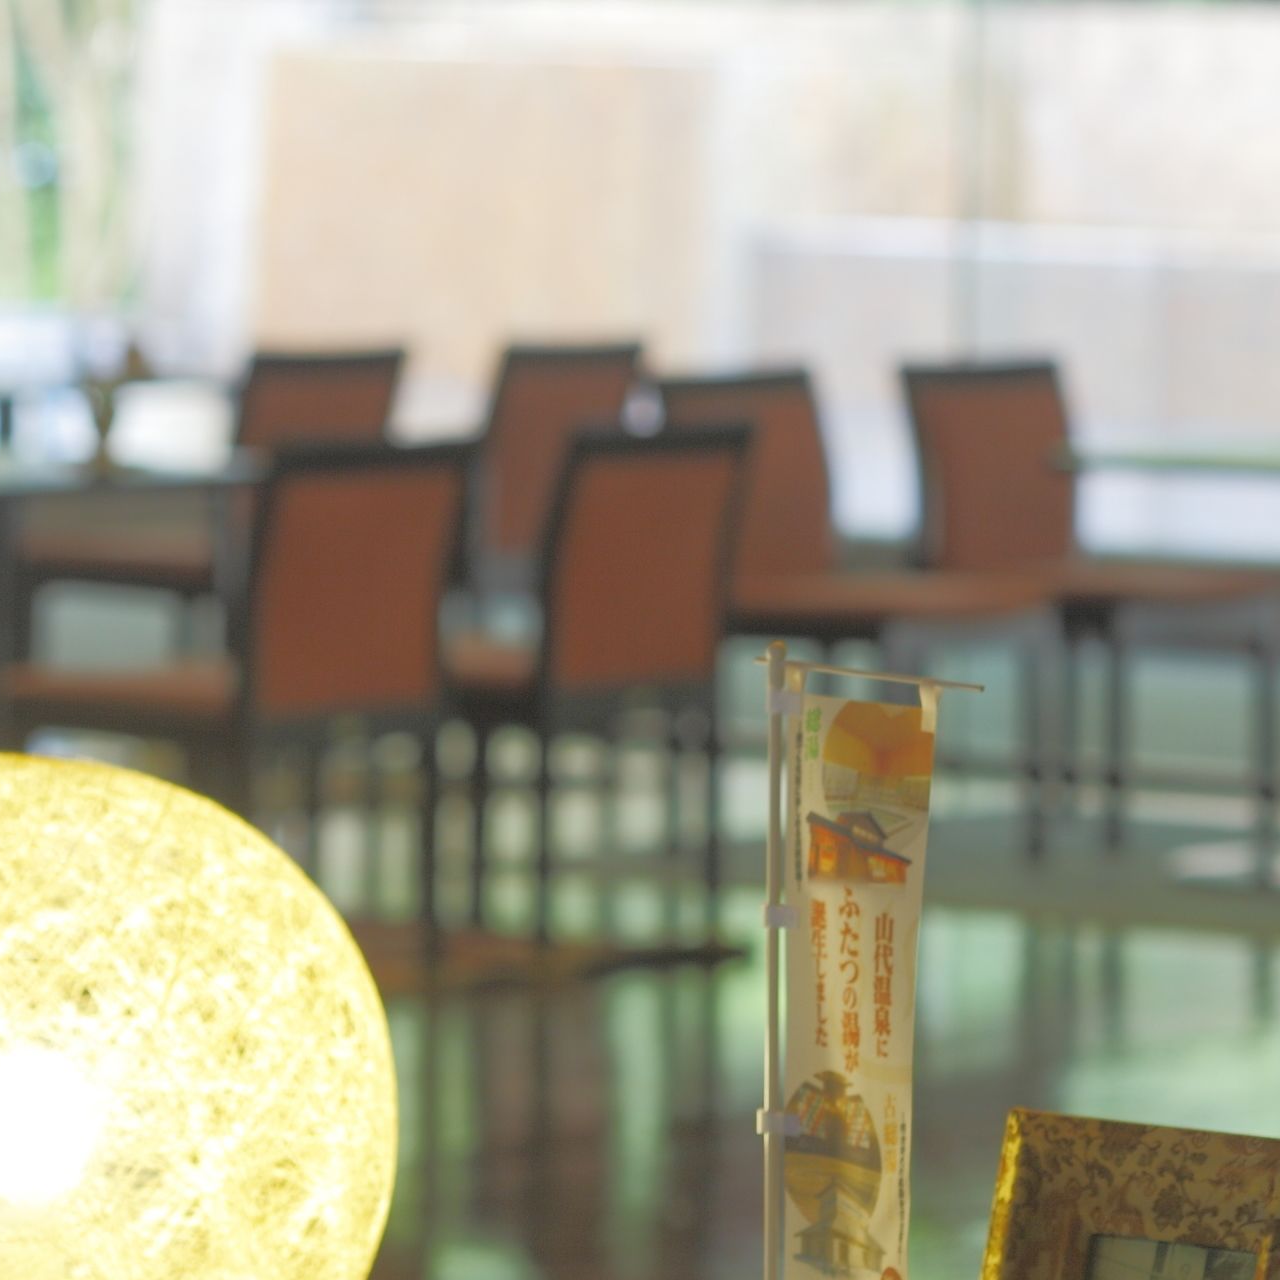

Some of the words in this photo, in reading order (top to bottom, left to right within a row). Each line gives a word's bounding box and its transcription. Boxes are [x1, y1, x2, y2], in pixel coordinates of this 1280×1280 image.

[873, 911, 895, 1058] 山代温泉に
